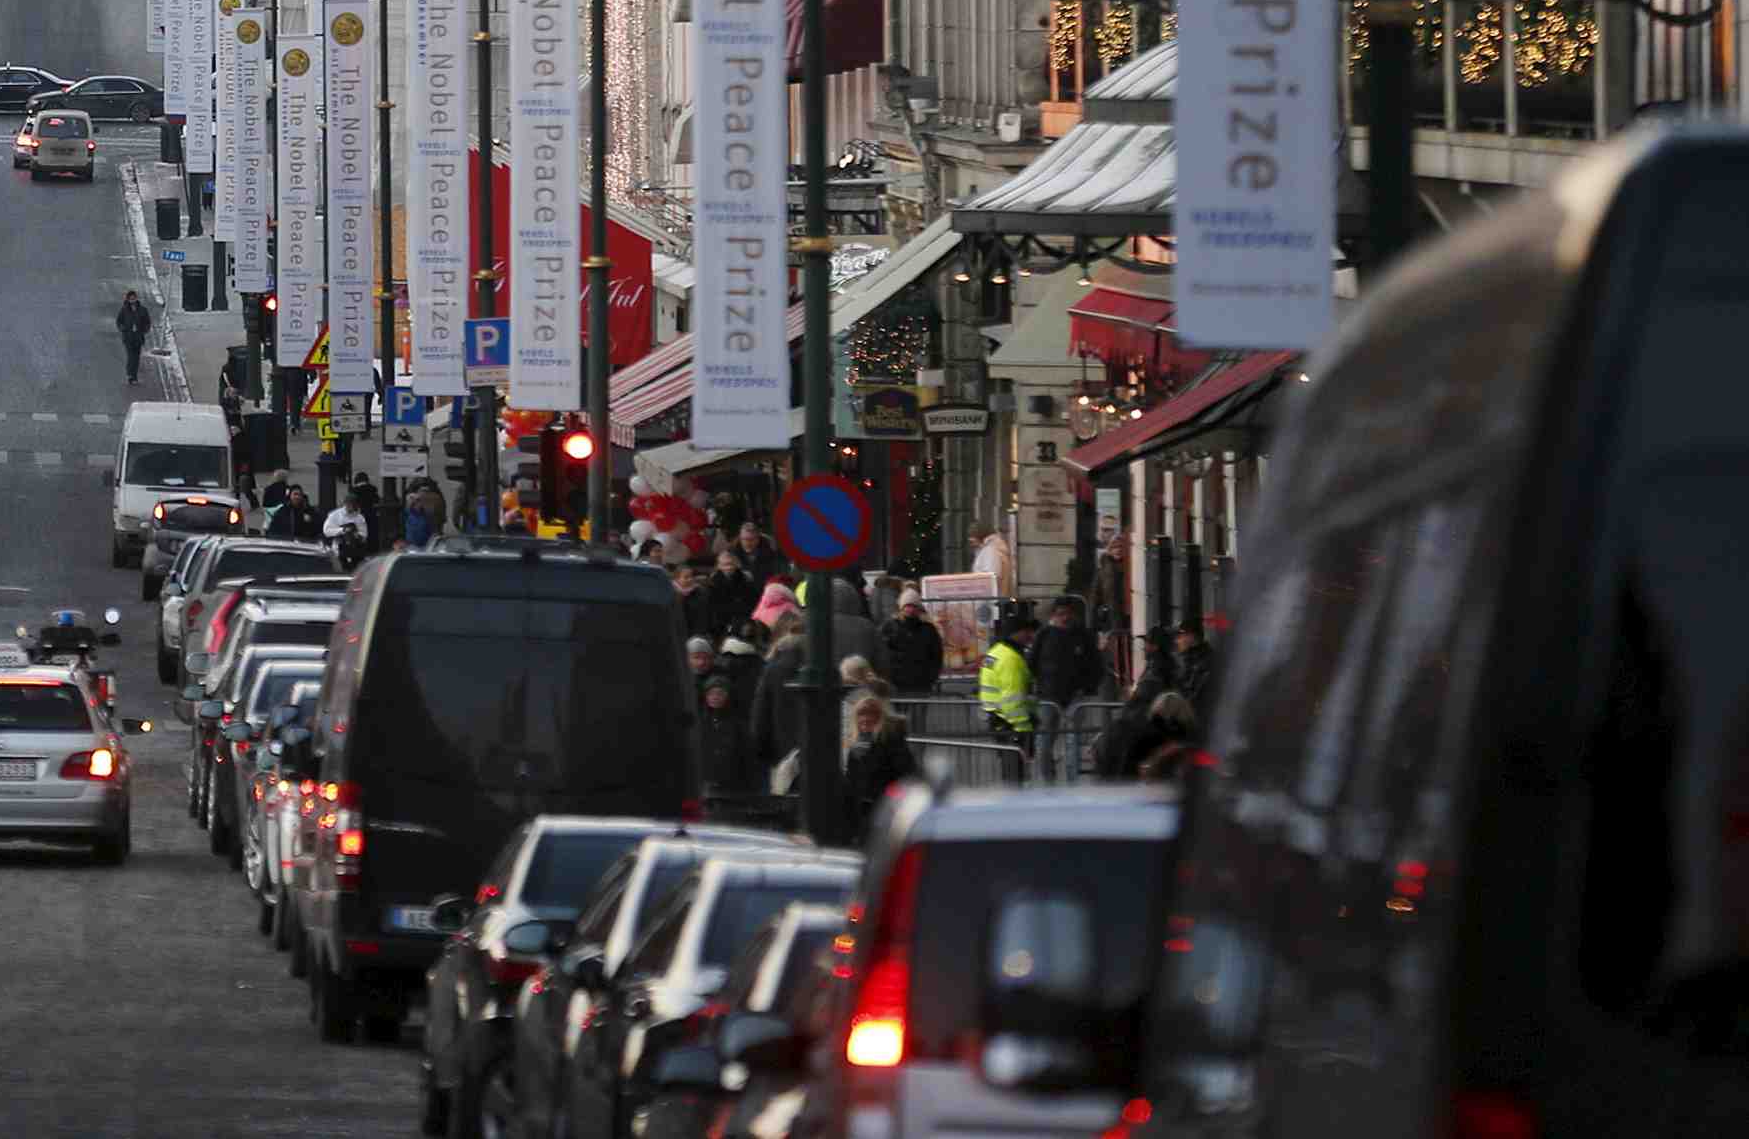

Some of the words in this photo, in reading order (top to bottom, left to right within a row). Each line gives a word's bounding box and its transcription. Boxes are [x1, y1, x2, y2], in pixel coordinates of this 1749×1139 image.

[193, 16, 206, 54] Nobel
[193, 65, 205, 103] Peace
[244, 59, 260, 86] The
[340, 65, 362, 105] The
[429, 53, 456, 134] Nobel
[193, 114, 207, 148] Prize
[244, 95, 260, 142] Nobel
[289, 92, 308, 126] The
[723, 55, 765, 192] Peace
[289, 136, 308, 192] Nobel
[341, 117, 363, 182] Nobel
[245, 158, 260, 205] Peace
[533, 124, 565, 224] Peace
[430, 162, 456, 243] Peace
[245, 219, 261, 260] Prize
[289, 210, 307, 265] Peace
[341, 205, 363, 270] Peace
[290, 282, 309, 330] Prize
[431, 269, 458, 341] Prize
[534, 256, 565, 342] Prize
[724, 234, 768, 356] Prize
[344, 291, 366, 348] Prize
[476, 325, 500, 361] P
[395, 392, 417, 421] P
[929, 414, 985, 428] MINIBANK
